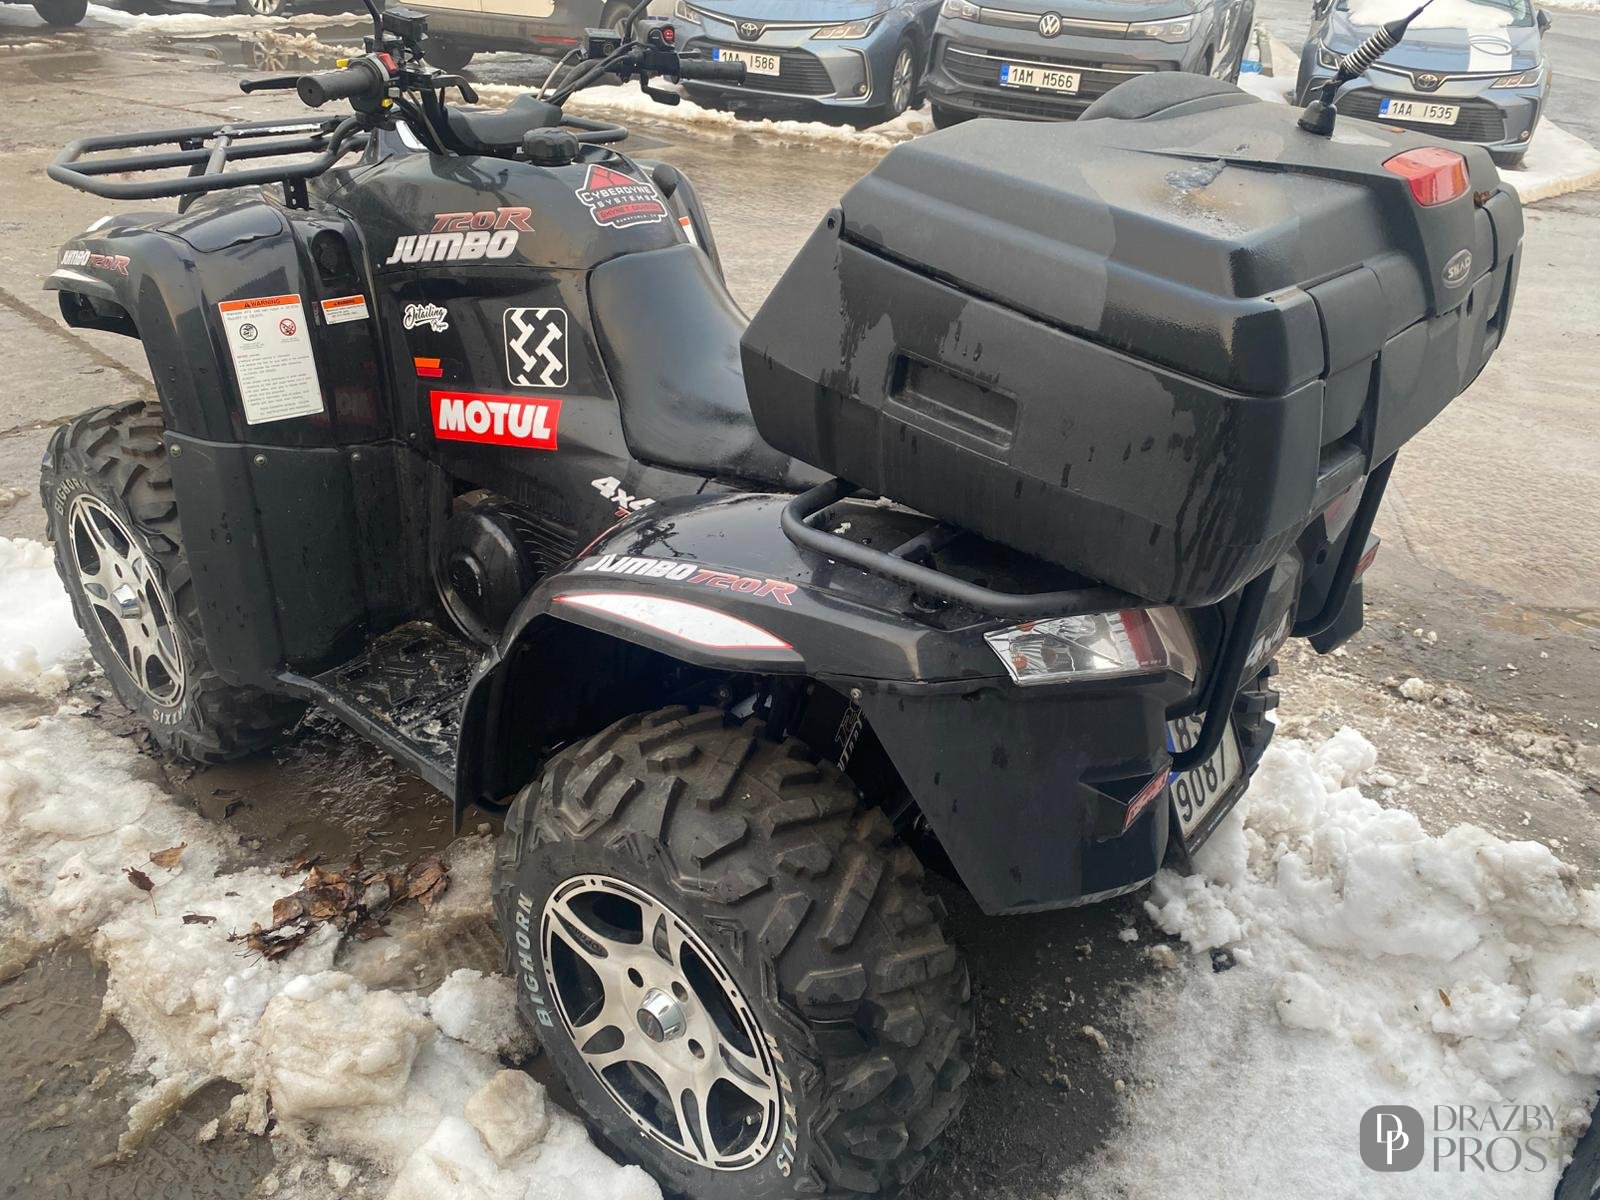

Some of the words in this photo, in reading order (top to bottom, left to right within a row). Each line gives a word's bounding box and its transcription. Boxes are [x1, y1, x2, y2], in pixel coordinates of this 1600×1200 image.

[722, 51, 740, 62] 1AA
[1012, 68, 1034, 84] 1AM
[1042, 71, 1074, 89] M566
[1392, 102, 1413, 116] 1AA
[581, 185, 652, 202] CYBERDYNE
[385, 230, 519, 265] JUMBO
[250, 298, 281, 308] WARNING
[439, 398, 551, 440] MOTUL
[55, 478, 91, 516] BIGHORN
[584, 553, 698, 582] JUMBO
[516, 892, 554, 1028] BIGHORN
